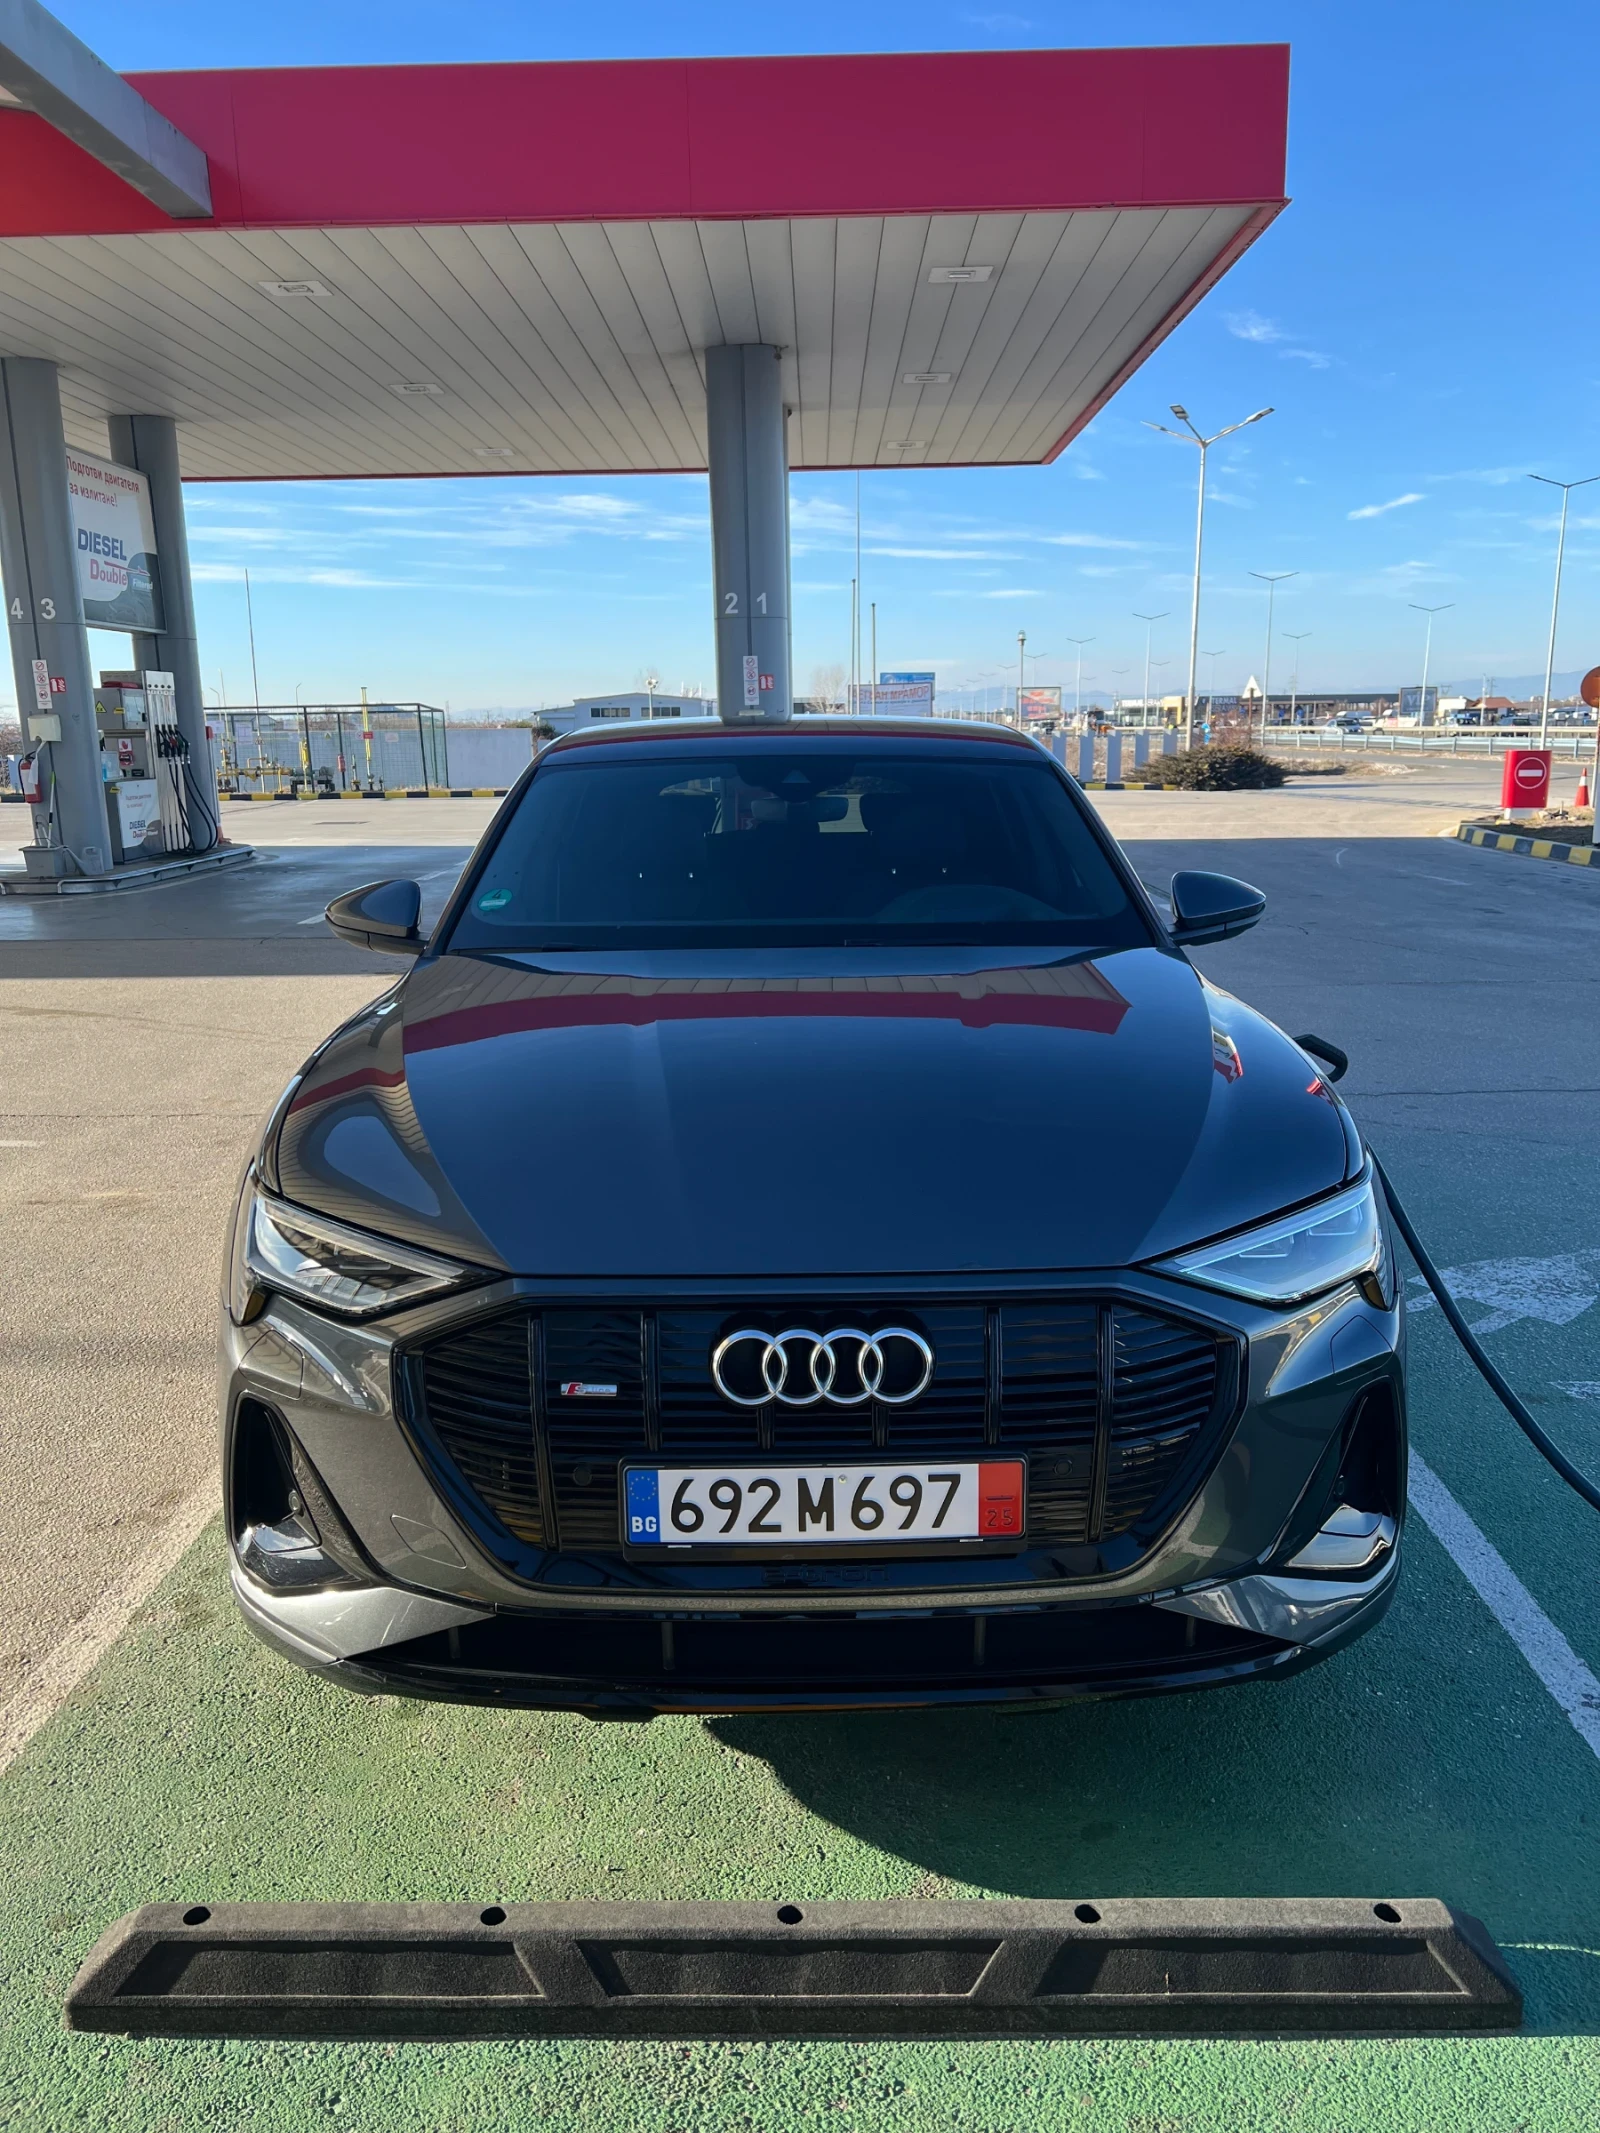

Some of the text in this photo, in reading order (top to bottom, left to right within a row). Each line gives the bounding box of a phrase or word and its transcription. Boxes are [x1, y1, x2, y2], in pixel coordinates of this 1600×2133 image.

[66, 455, 140, 494] Подготви двигателя
[69, 482, 118, 507] за излитане!
[78, 528, 127, 561] DIESEL
[90, 559, 128, 586] Double
[10, 597, 56, 620] 4 3
[725, 592, 767, 614] 2 1
[670, 1474, 961, 1534] 692 M 697
[631, 1515, 657, 1533] BG
[986, 1507, 1014, 1528] 25
